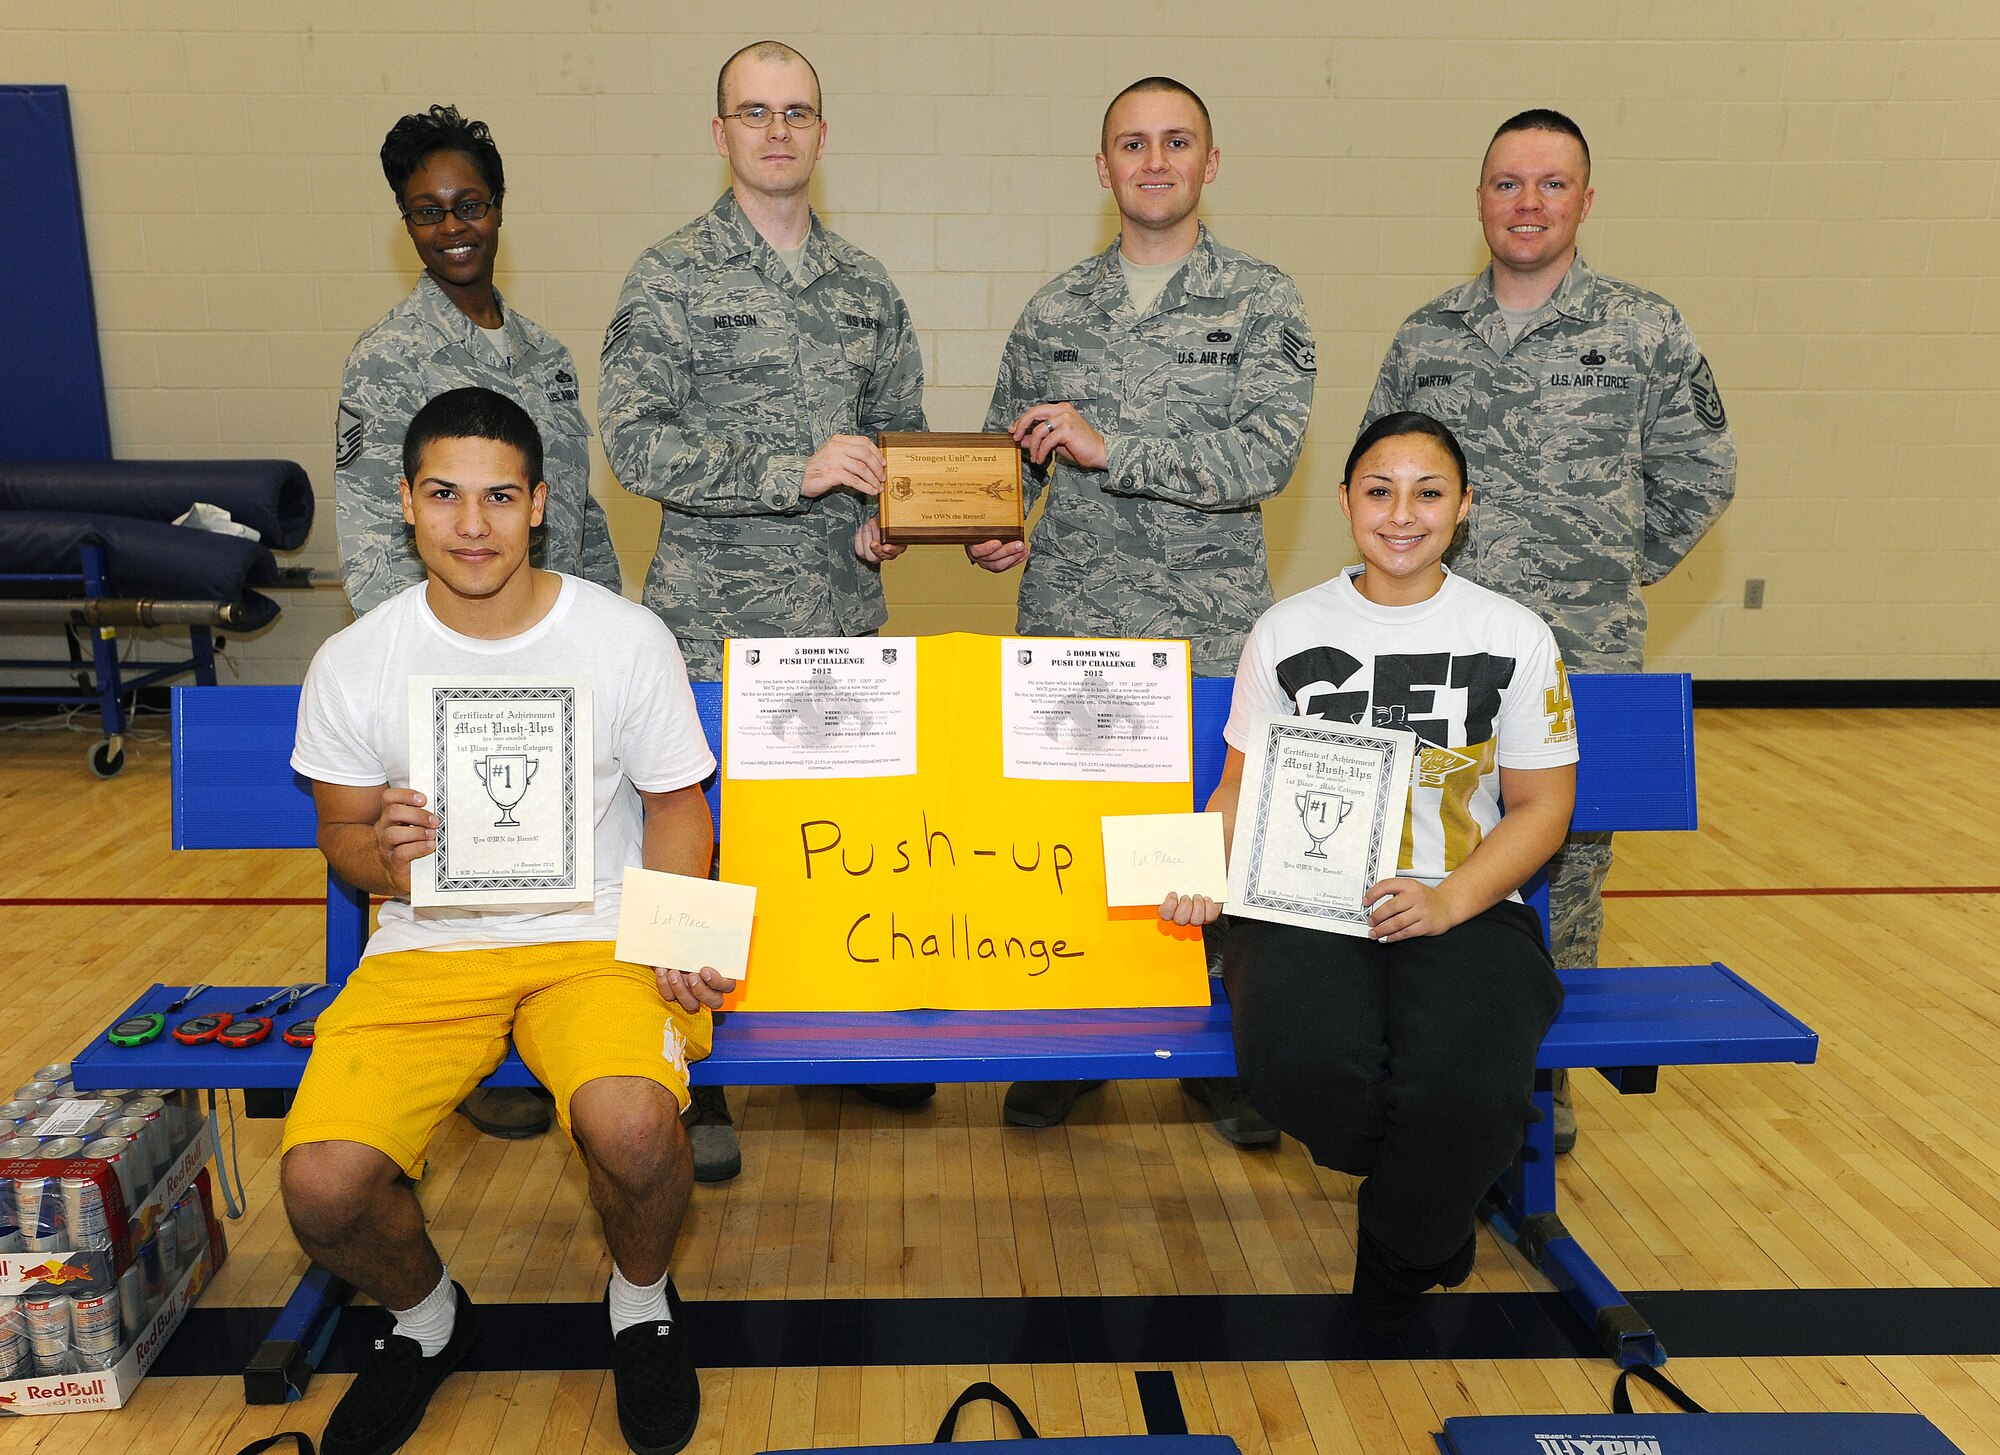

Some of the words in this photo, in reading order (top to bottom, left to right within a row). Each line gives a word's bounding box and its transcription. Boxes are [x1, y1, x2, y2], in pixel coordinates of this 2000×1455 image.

[713, 314, 758, 329] NELSON
[1053, 350, 1078, 363] GREEN
[1178, 352, 1197, 364] U.S.
[1199, 352, 1218, 364] AIR
[1551, 374, 1571, 387] U.S.
[1573, 375, 1594, 388] AIR
[1596, 375, 1630, 389] FORCE
[817, 657, 865, 665] CHALLENGE
[1089, 660, 1136, 668] CHALLENGE
[1276, 646, 1516, 748] GET
[453, 711, 494, 719] Certificate
[496, 711, 504, 719] of
[506, 710, 555, 721] Achievement
[453, 722, 487, 737] Most
[491, 721, 554, 736] Push-Ups
[469, 744, 489, 753] Place
[495, 744, 521, 753] Female
[522, 744, 553, 752] Category
[1283, 747, 1320, 759] Certificate
[1331, 754, 1375, 767] Achievement
[492, 765, 512, 788] #1
[1282, 757, 1312, 771] Most
[1315, 761, 1372, 781] Push-Ups
[1297, 779, 1314, 787] Place
[1320, 783, 1336, 791] Male
[1337, 785, 1365, 797] Category
[1310, 800, 1327, 824] #1
[1152, 850, 1184, 867] Place
[679, 912, 709, 929] Place
[847, 912, 1084, 976] Challange
[75, 1397, 106, 1405] DRINK
